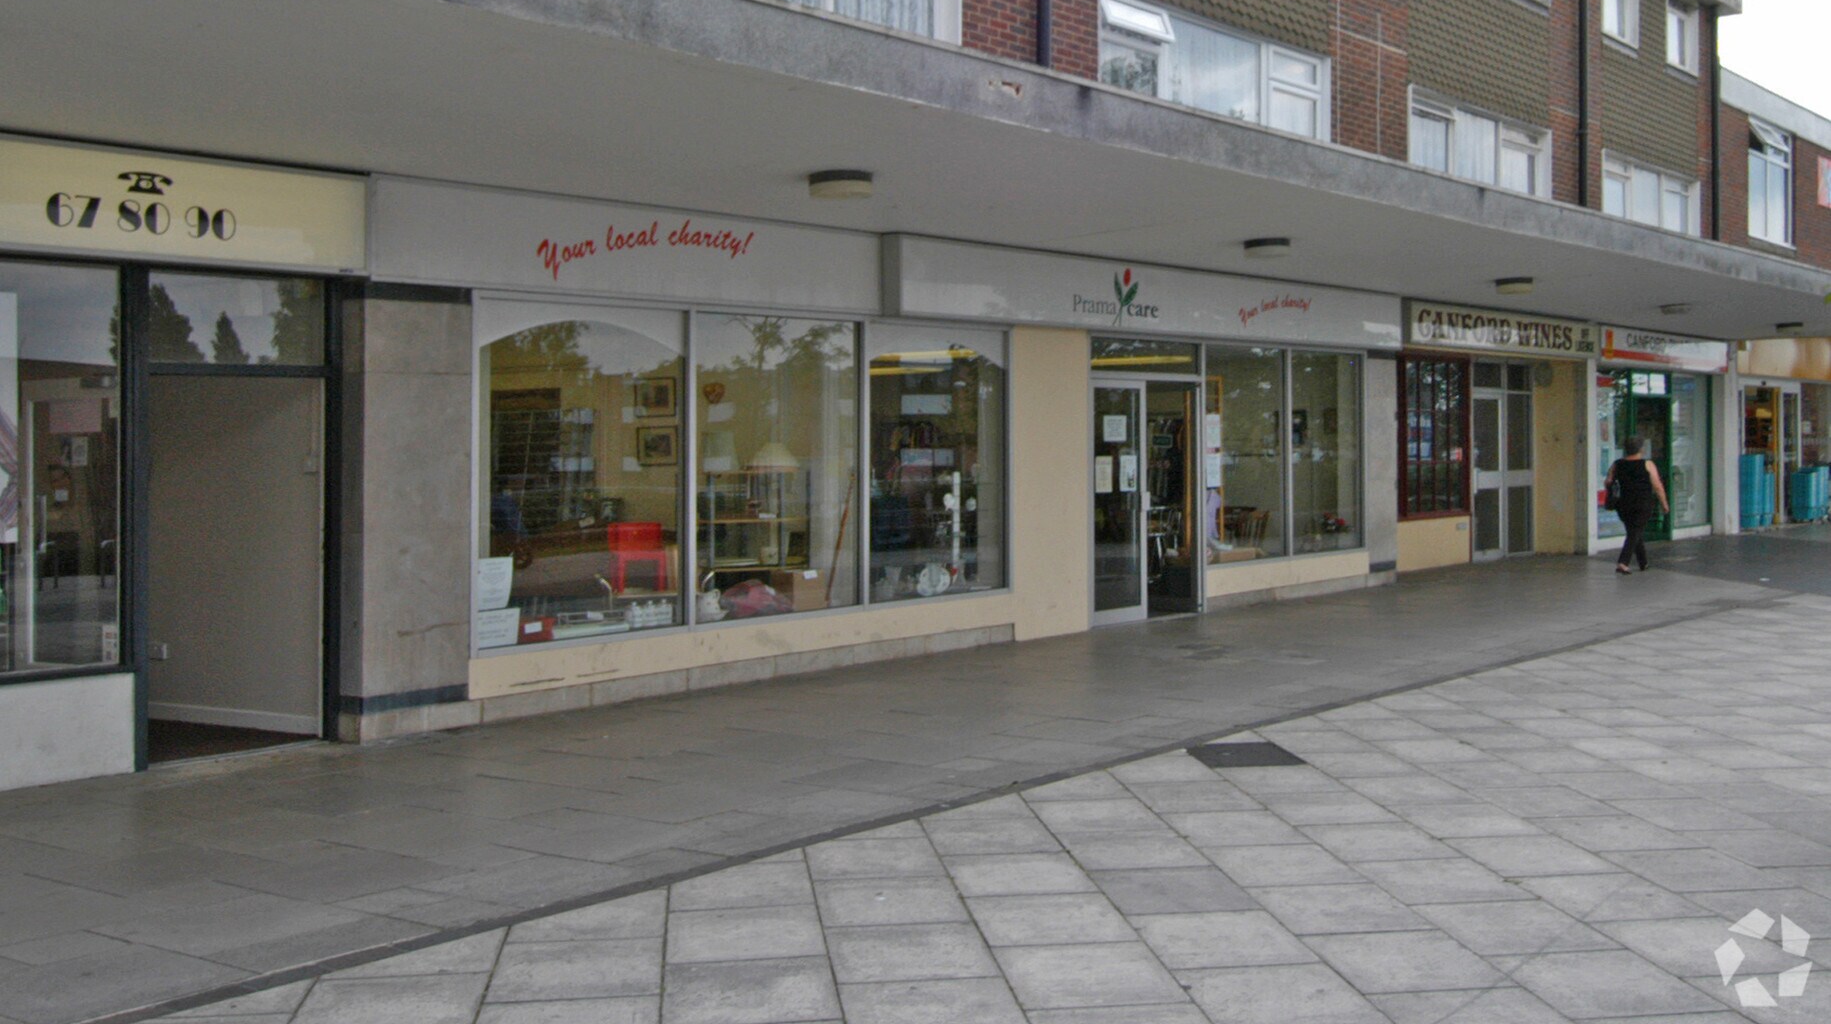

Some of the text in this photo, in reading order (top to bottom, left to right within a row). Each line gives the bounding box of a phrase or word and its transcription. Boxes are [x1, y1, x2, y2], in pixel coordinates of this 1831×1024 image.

[46, 192, 237, 242] 67 80 90
[536, 219, 754, 281] Your local charity!
[1127, 303, 1159, 319] care
[1417, 308, 1573, 352] CANFORD WINES
